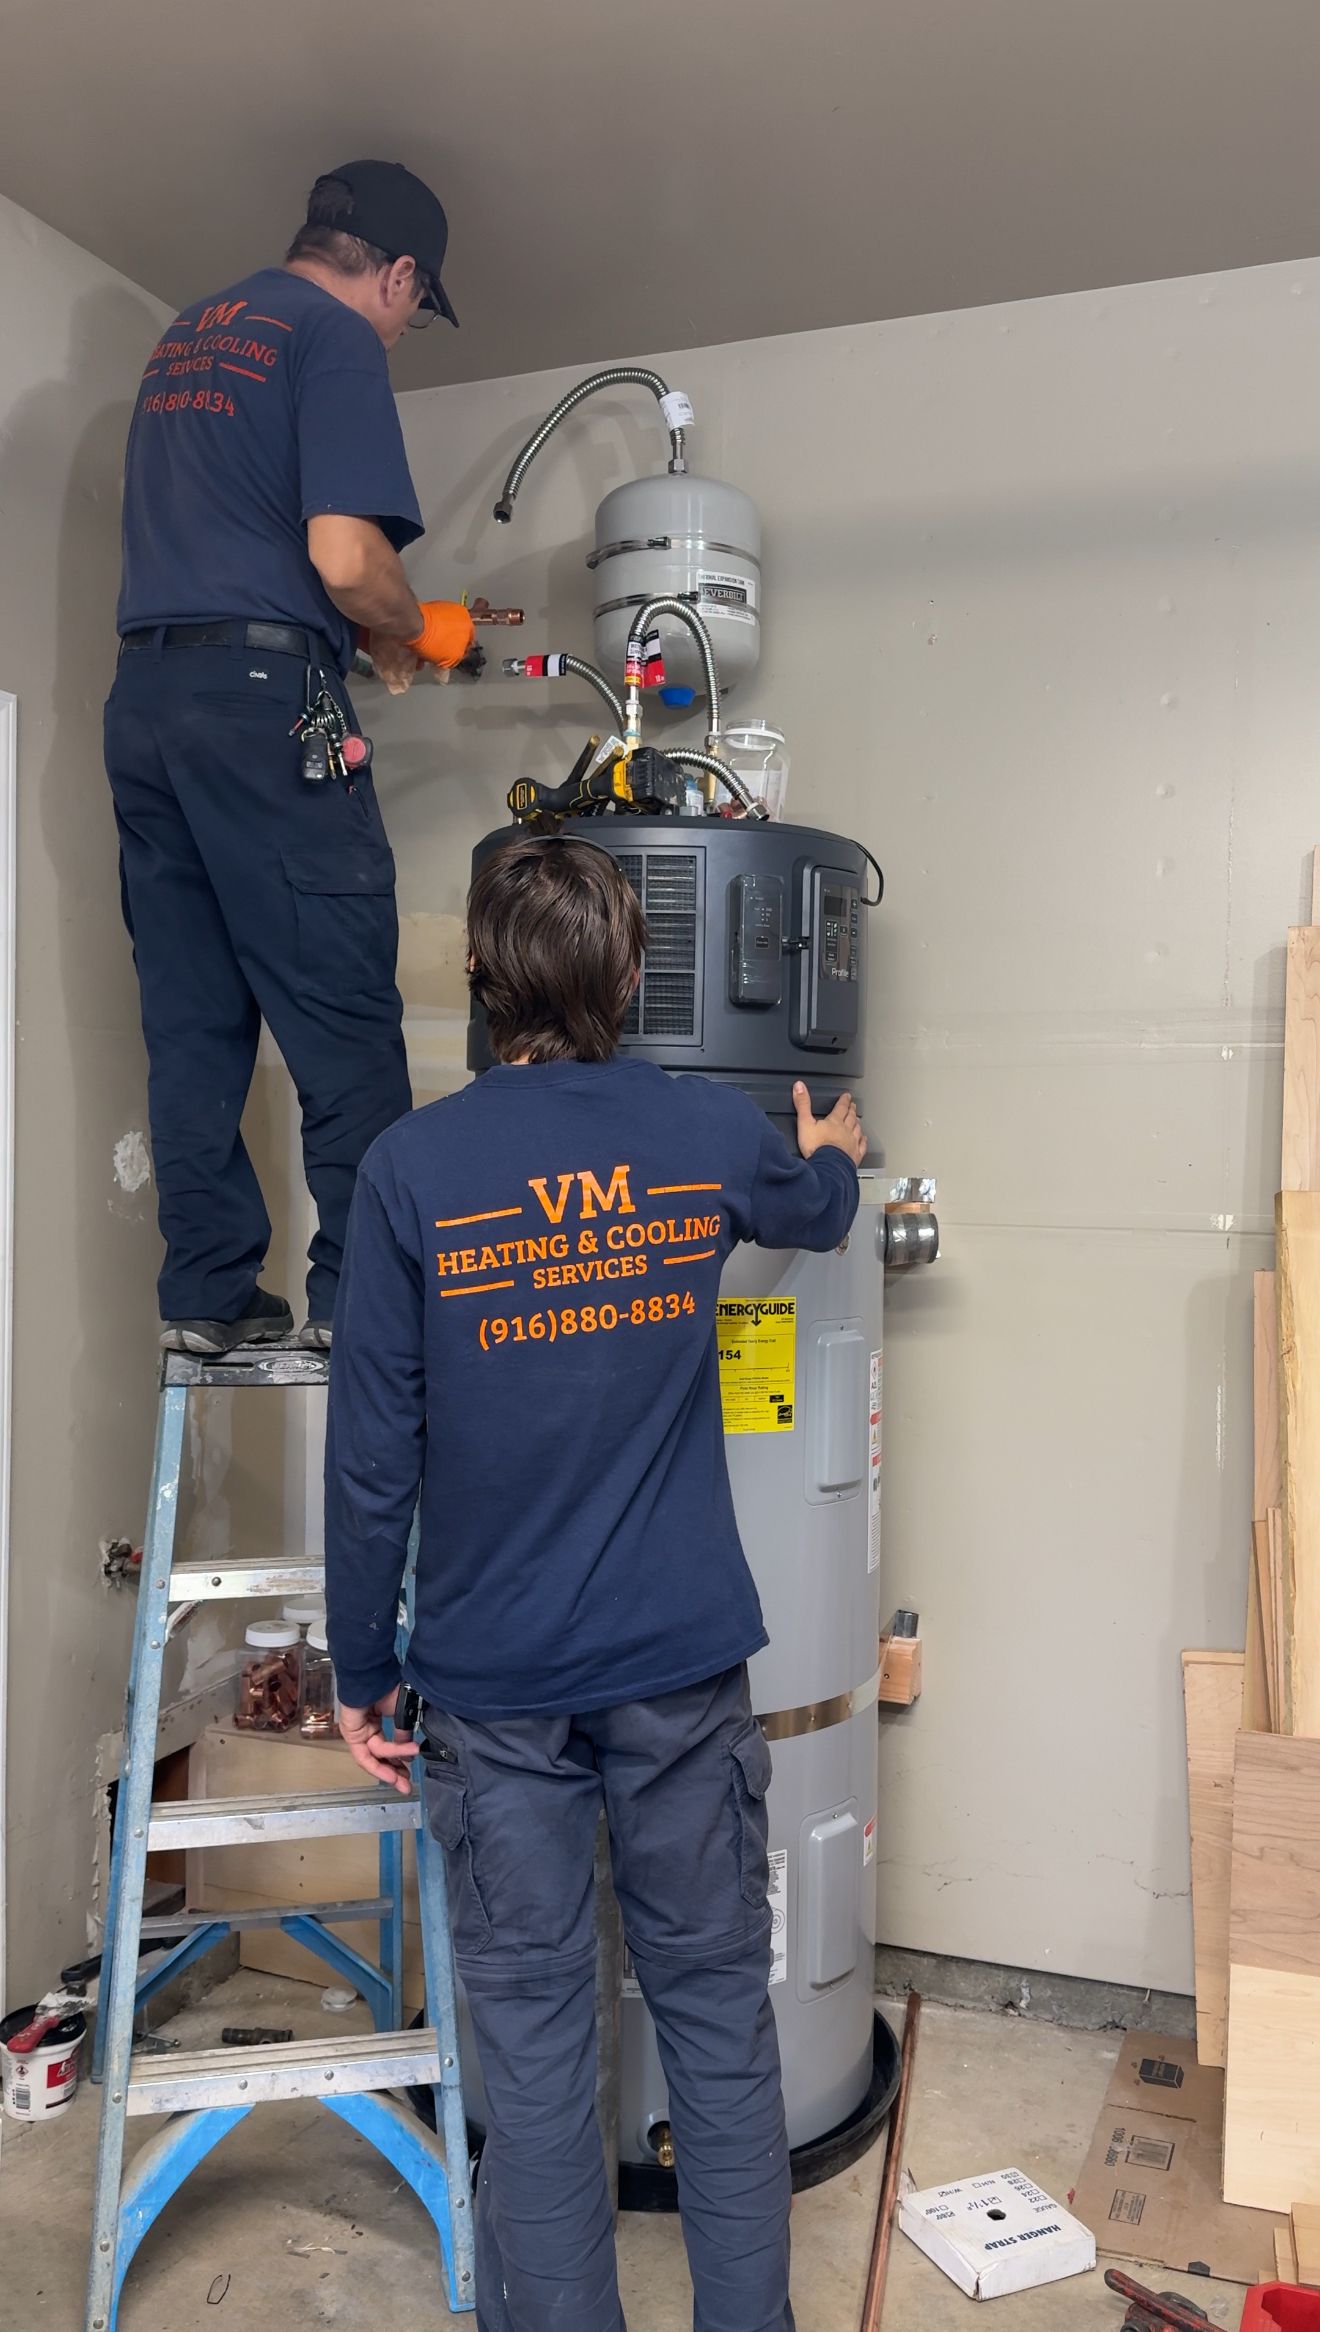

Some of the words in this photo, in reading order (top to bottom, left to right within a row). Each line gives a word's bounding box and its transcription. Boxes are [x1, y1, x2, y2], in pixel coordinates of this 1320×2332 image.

[195, 300, 249, 332] VM
[149, 341, 193, 361] EATING
[203, 334, 278, 367] COOLING
[704, 587, 744, 602] EVERBILT
[831, 968, 849, 977] Profile
[528, 1164, 636, 1224] VM
[437, 1234, 570, 1277] HEATING
[577, 1229, 598, 1255] &
[606, 1215, 721, 1251] COOLING
[532, 1255, 648, 1290] SERVICES
[478, 1291, 696, 1352] (916)880-8834
[718, 1349, 742, 1361] 154
[984, 2236, 1018, 2251] STRAP
[1017, 2224, 1062, 2241] HANGER
